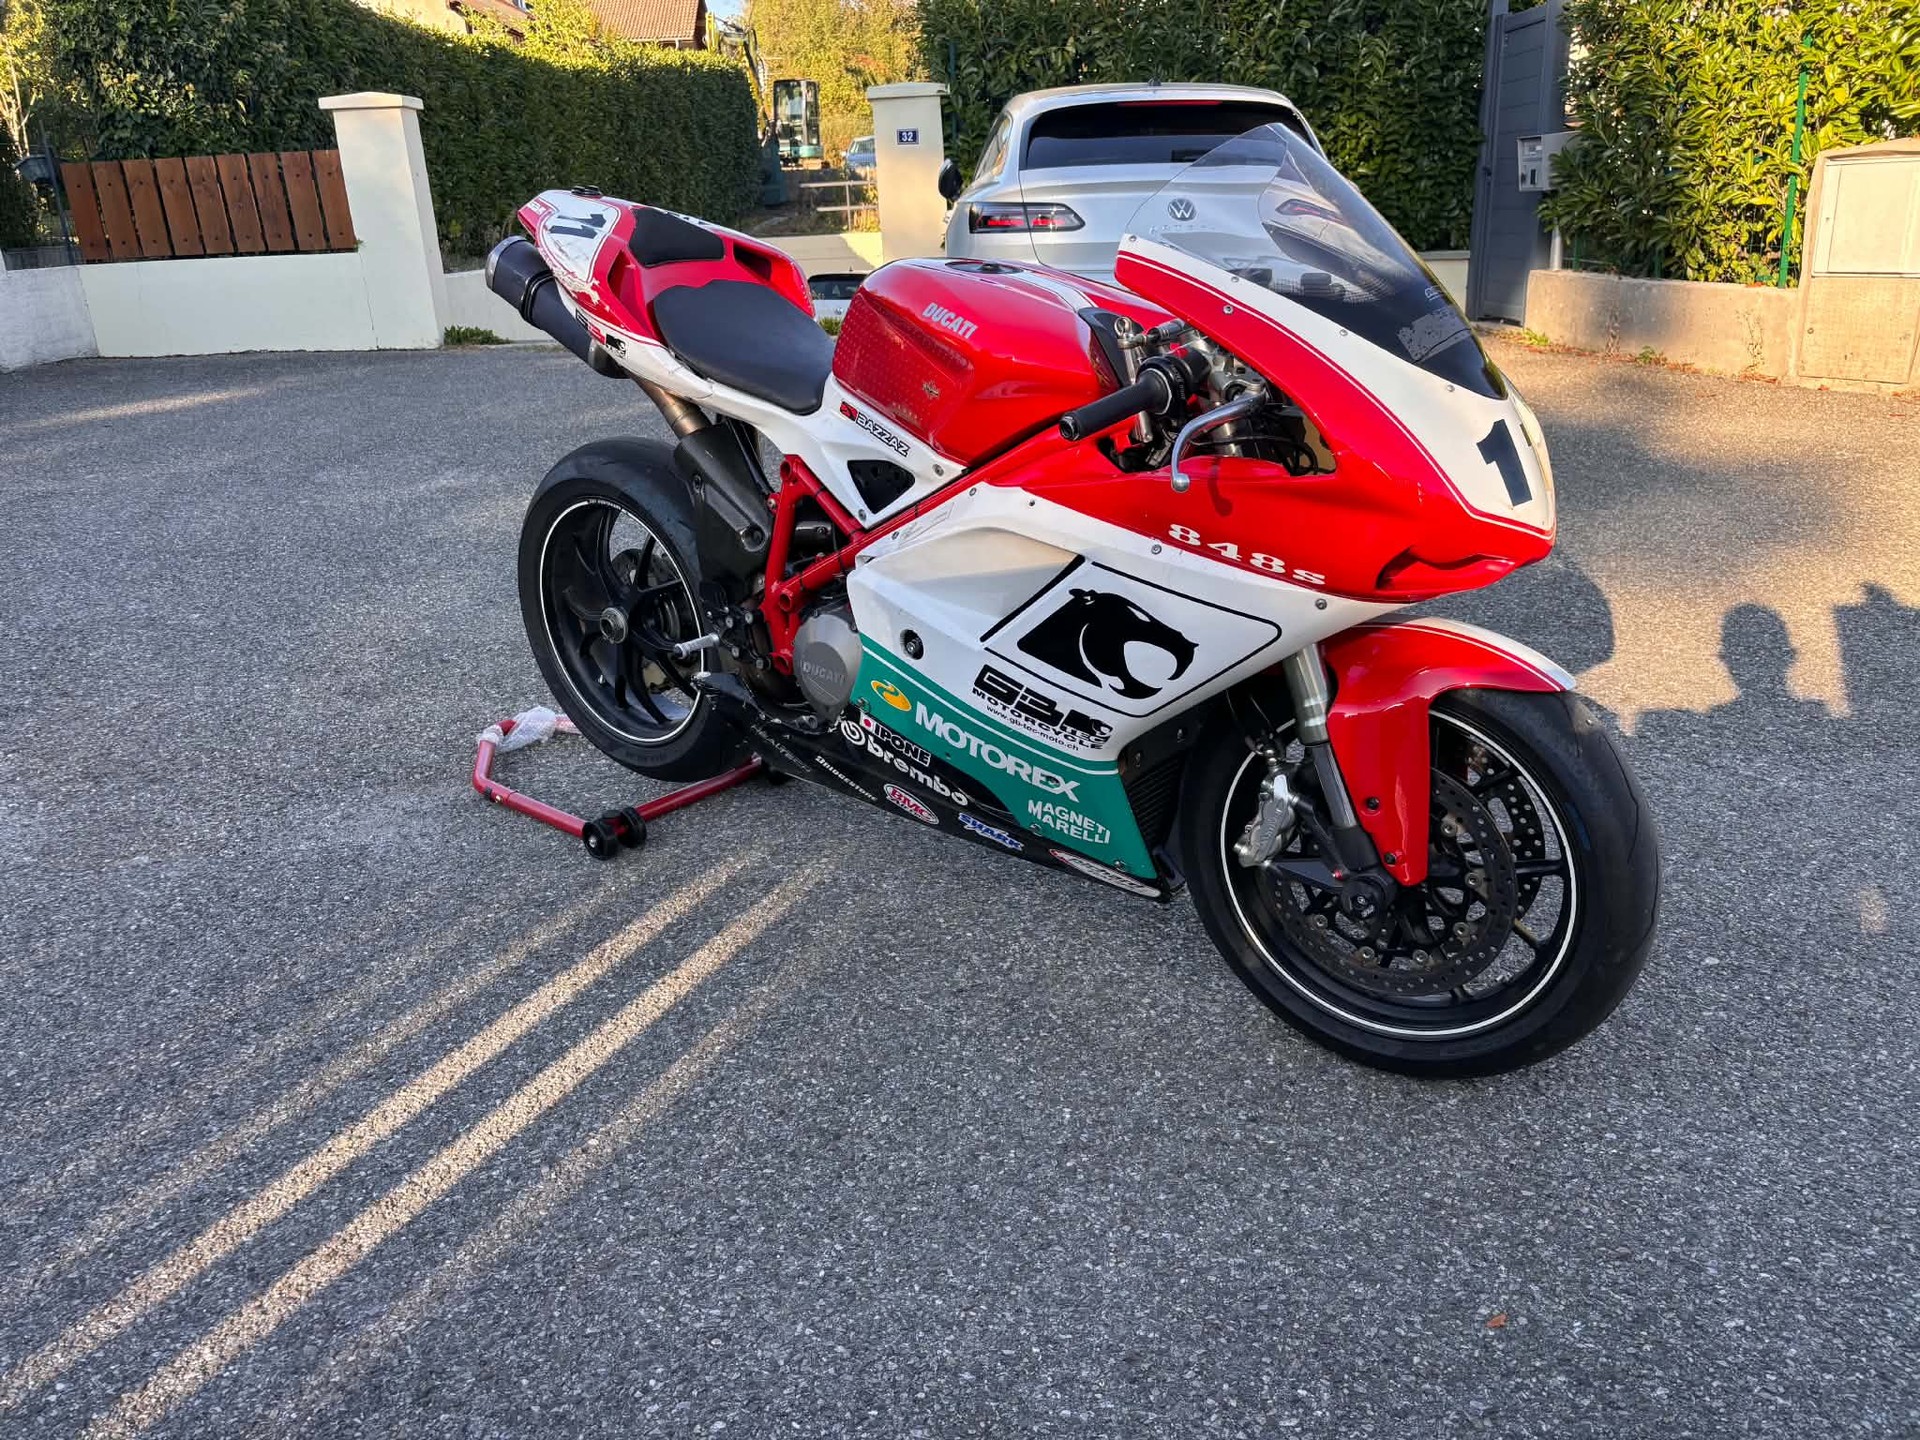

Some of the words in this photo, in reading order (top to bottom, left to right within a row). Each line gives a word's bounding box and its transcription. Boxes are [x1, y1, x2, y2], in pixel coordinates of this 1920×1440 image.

[901, 131, 914, 142] 32
[922, 302, 978, 338] DUCATI
[855, 411, 911, 458] BAZZAZ
[1476, 419, 1533, 507] 1
[972, 687, 1104, 750] MOTORCYCLE
[872, 724, 932, 767] IPONE
[915, 701, 1080, 803] MOTOREX
[866, 734, 969, 806] brembo
[959, 812, 1024, 850] SHARK
[1028, 799, 1111, 843] MAGNETI
